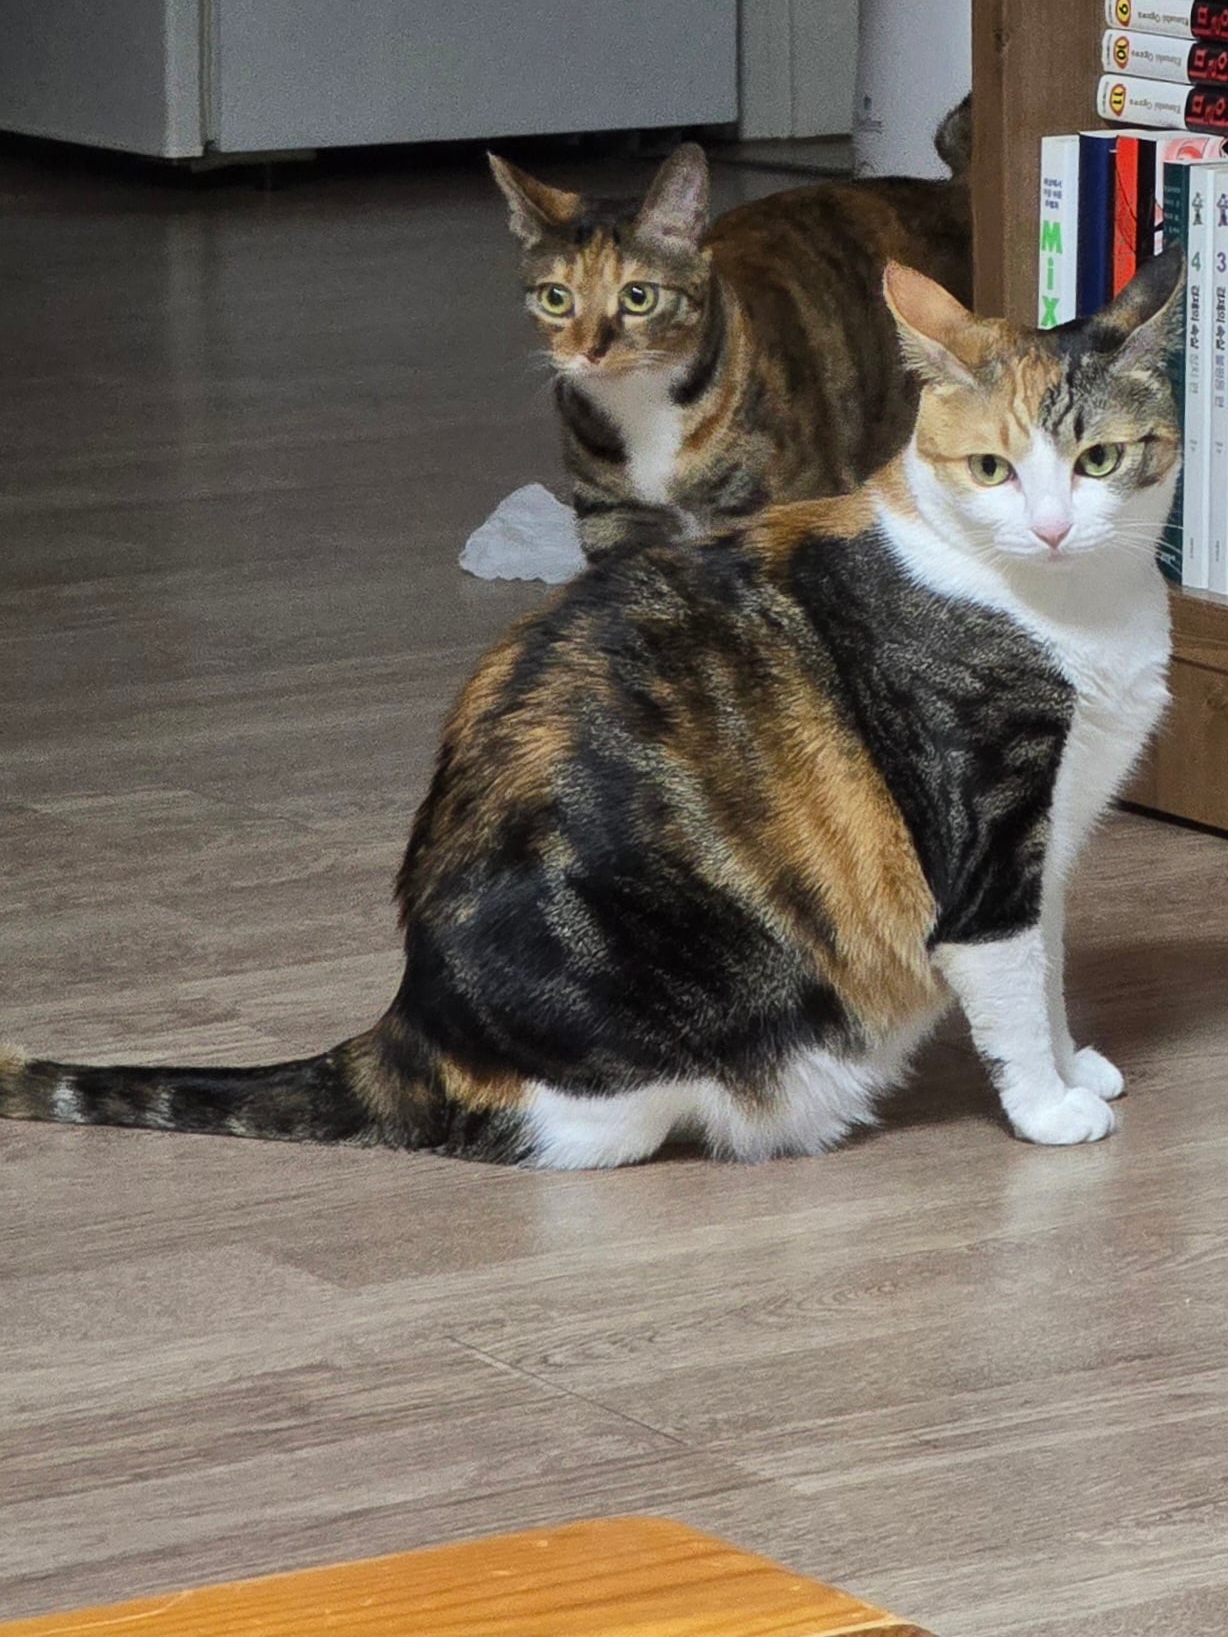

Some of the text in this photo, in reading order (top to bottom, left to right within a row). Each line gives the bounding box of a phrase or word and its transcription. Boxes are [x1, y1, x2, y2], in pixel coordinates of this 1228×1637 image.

[1117, 2, 1129, 15] 9
[1115, 39, 1128, 62] 10
[1111, 88, 1123, 107] 11
[1191, 251, 1202, 272] 4
[1216, 252, 1227, 273] 3
[1040, 220, 1063, 328] MiX
[1190, 285, 1201, 323] 경제의
[1215, 286, 1227, 323] 경제의
[1190, 324, 1201, 350] 속살
[1215, 326, 1227, 351] 속살
